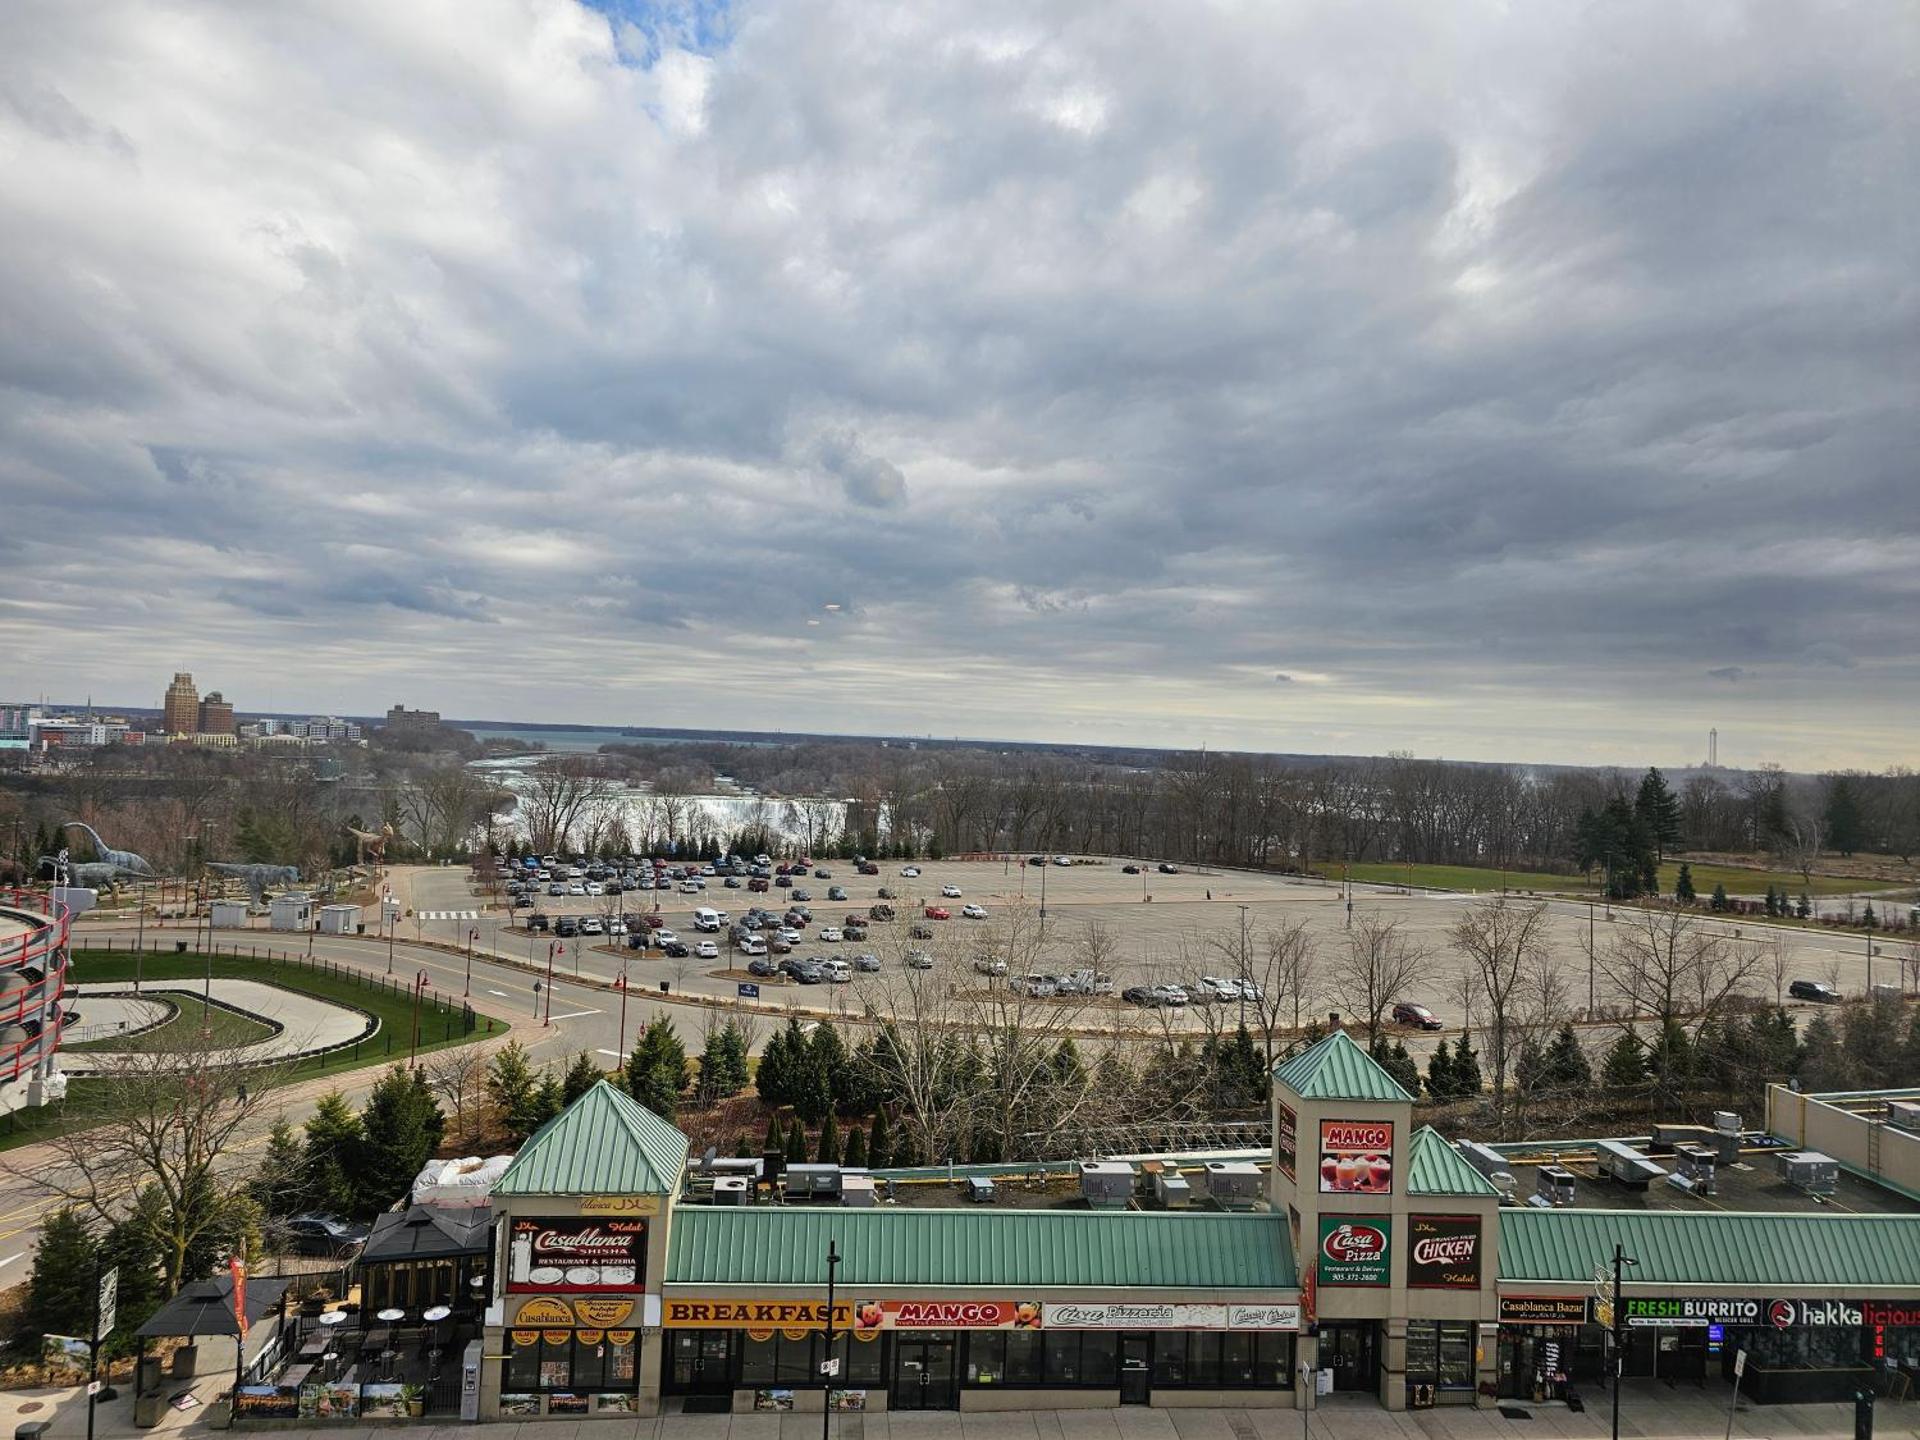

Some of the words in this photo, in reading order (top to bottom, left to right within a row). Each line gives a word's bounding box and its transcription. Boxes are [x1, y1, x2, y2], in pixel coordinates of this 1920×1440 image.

[1328, 1128, 1387, 1145] MANGO
[534, 1228, 632, 1252] Casablanca
[1333, 1230, 1374, 1249] Casa
[1345, 1249, 1380, 1261] Pizza
[1414, 1238, 1474, 1262] CHICKEN
[670, 1304, 850, 1322] BREAKFAST
[897, 1303, 1000, 1321] MANGO
[1106, 1306, 1173, 1319] Pizzeria
[1502, 1301, 1554, 1312] Casablanca
[1556, 1302, 1584, 1313] Bazar
[1628, 1301, 1680, 1315] FRESH
[1684, 1302, 1758, 1317] BURRITO
[520, 1312, 571, 1322] Casablanca
